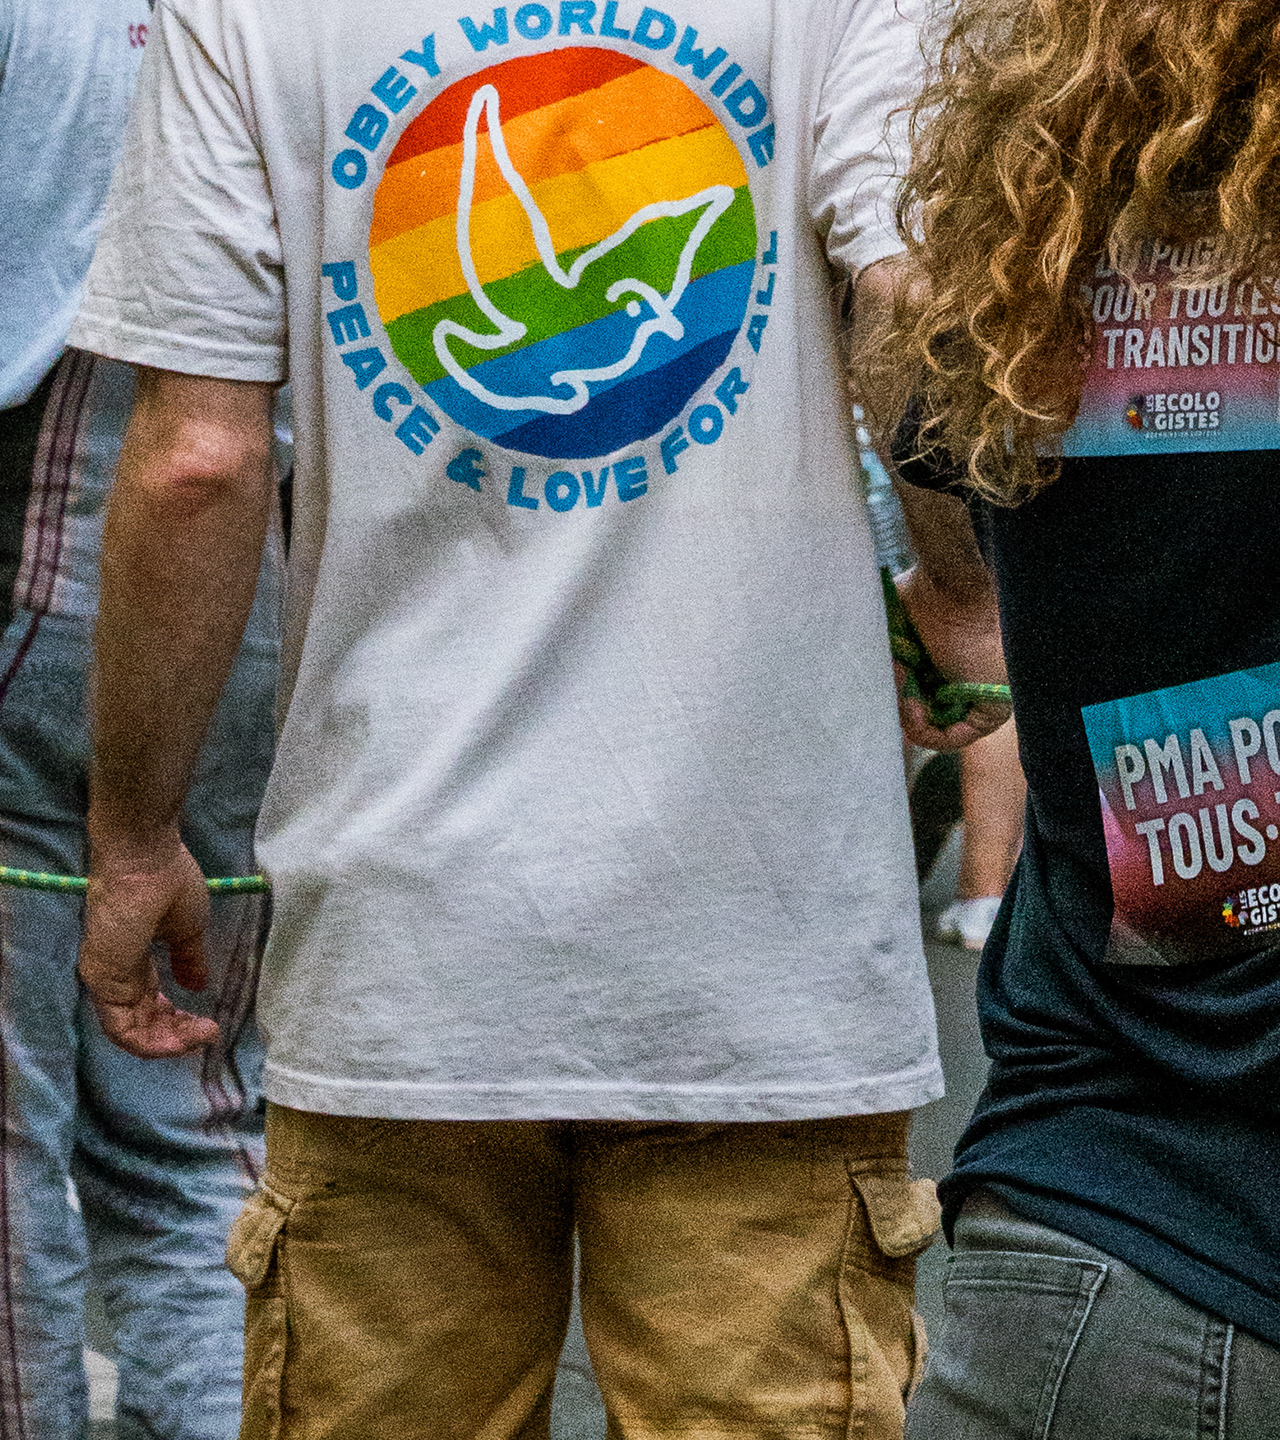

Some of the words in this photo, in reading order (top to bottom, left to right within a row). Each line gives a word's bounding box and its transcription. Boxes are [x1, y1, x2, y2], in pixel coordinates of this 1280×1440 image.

[331, 33, 441, 190] OBEY
[457, 0, 776, 169] WORLDWIDE
[321, 260, 441, 457] PEACE
[446, 448, 486, 492] &
[506, 462, 648, 513] LOVE
[661, 366, 749, 475] FOR
[746, 230, 778, 353] ALL
[1154, 411, 1221, 431] GISTES
[1115, 728, 1225, 812] PMA
